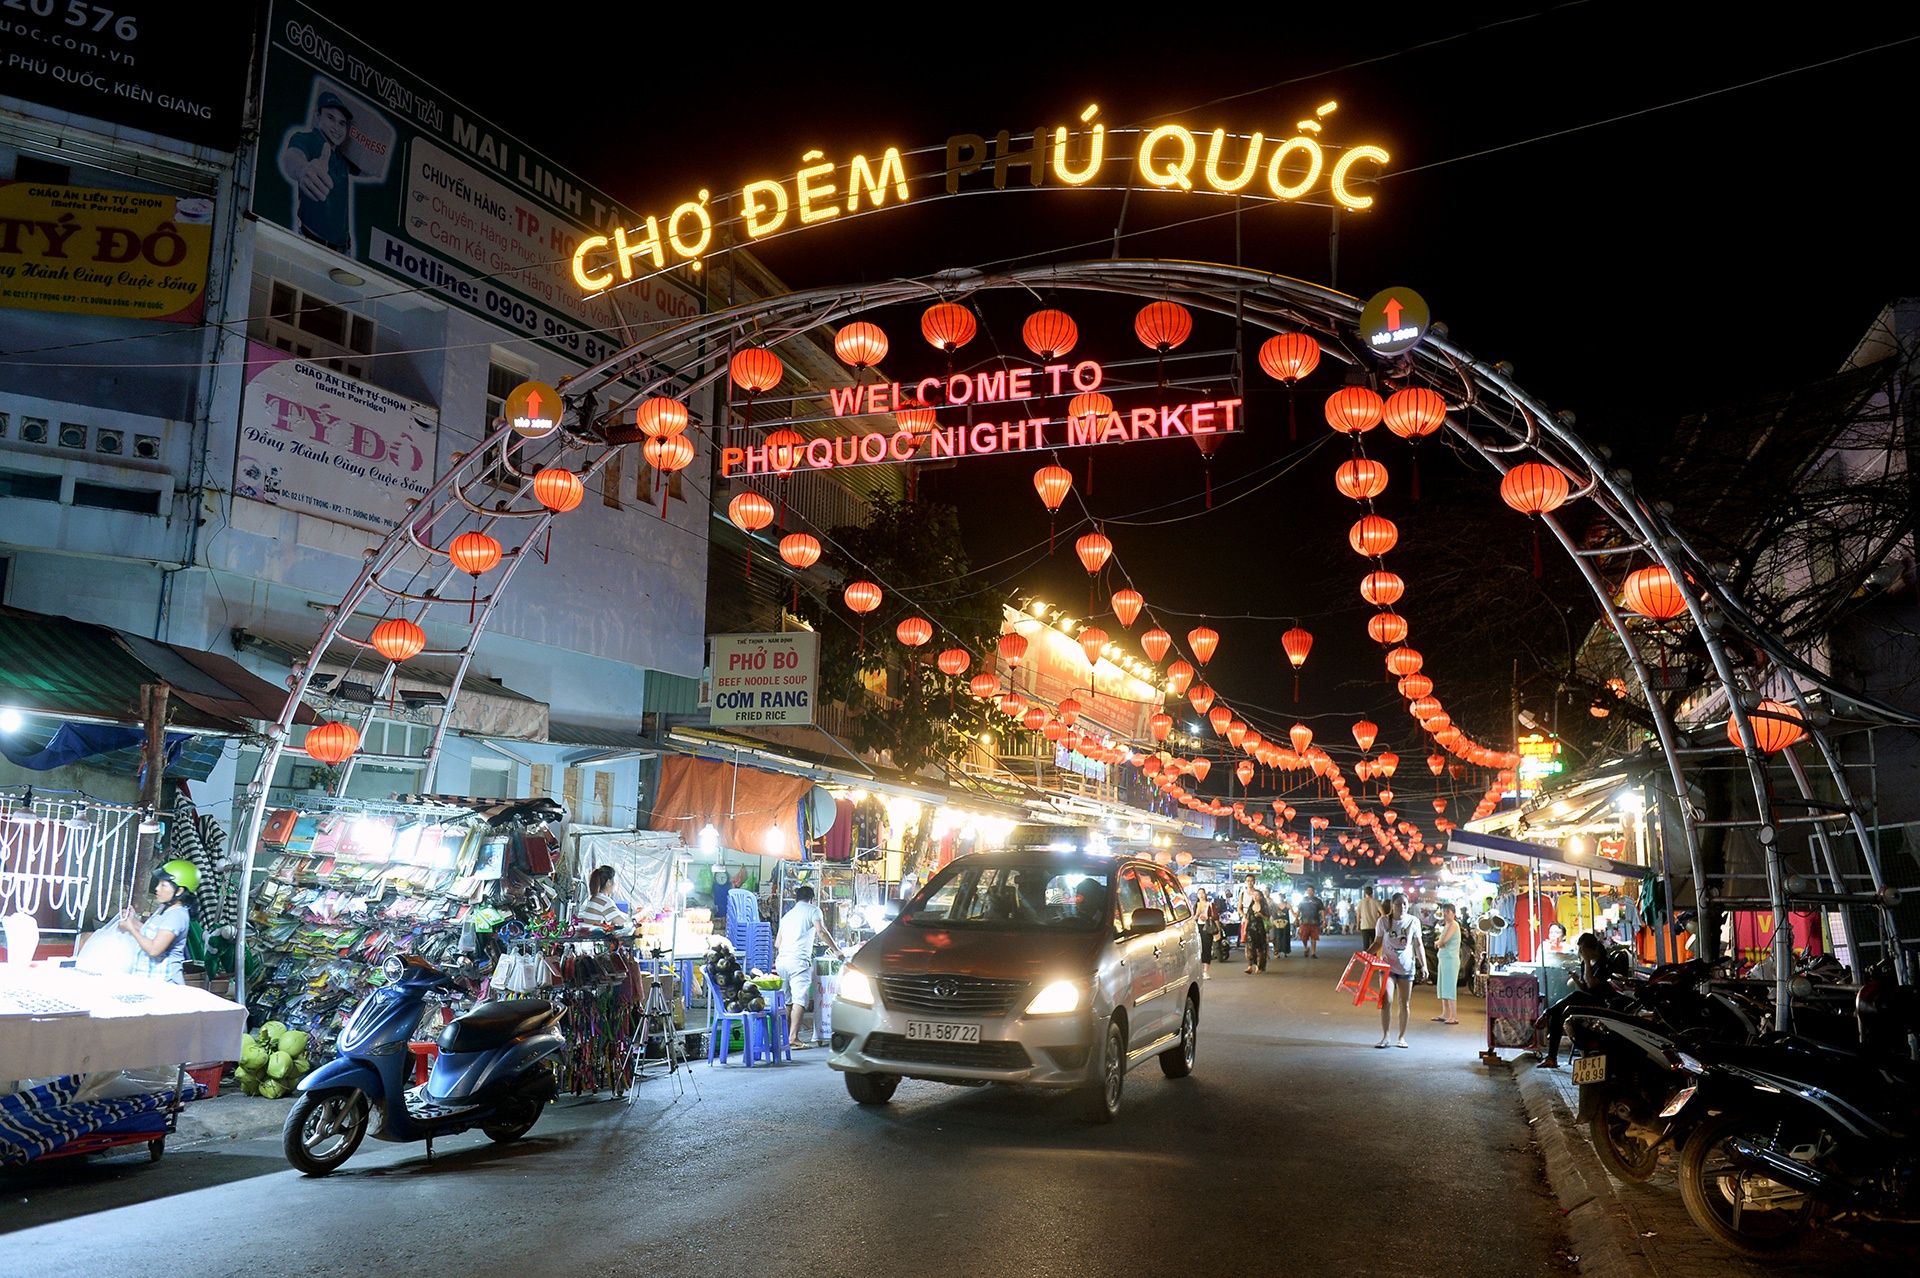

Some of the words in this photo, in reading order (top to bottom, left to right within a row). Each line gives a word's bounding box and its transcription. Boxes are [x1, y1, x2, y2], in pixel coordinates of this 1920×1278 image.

[64, 0, 138, 41] 576
[9, 54, 47, 74] PHÚ
[52, 65, 109, 93] QUỐC,
[115, 81, 152, 103] KIÊN
[158, 94, 212, 119] GIANG
[286, 20, 344, 71] CÔNG
[348, 54, 374, 88] TY
[375, 71, 412, 114] VẬN
[415, 96, 443, 132] TẢI
[453, 114, 508, 171] MAI
[518, 154, 583, 216] LINH
[350, 126, 386, 155] EXPRESS
[51, 200, 86, 210] (Buffet
[91, 203, 138, 214] Porridge)
[474, 193, 506, 221] HÀNG
[515, 205, 544, 244] TP.
[572, 189, 711, 291] CHỢ
[741, 146, 909, 238] ĐÊM
[946, 103, 1104, 195] PHÚ
[1139, 100, 1390, 209] QUỐC
[0, 212, 82, 258] TÝ
[91, 222, 188, 267] ĐÔ
[432, 197, 477, 232] Chuyên:
[481, 222, 508, 252] Hàng
[511, 239, 536, 264] Phục
[22, 262, 69, 281] Hành
[73, 267, 114, 286] Cùng
[117, 271, 154, 290] Cuộc
[158, 275, 198, 294] Sống
[430, 221, 461, 250] Cam
[466, 239, 487, 263] Kết
[490, 253, 519, 278] Giao
[523, 270, 552, 300] Hàng
[556, 285, 586, 317] Trong
[385, 239, 478, 304] Hotline:
[486, 290, 537, 329] 0903
[544, 318, 579, 350] 999
[315, 382, 346, 399] (Buffet
[348, 393, 387, 414] Porridge)
[381, 395, 406, 411] CHỌN
[830, 368, 1033, 416] WELCOME
[1040, 360, 1102, 396] TO
[265, 393, 340, 445] TÝ
[722, 445, 795, 477] PHU
[806, 430, 915, 468] QUOC
[932, 418, 1051, 457] NIGHT
[1067, 400, 1243, 445] MARKET
[244, 426, 286, 452] Đồng
[290, 440, 329, 464] Hành
[334, 452, 366, 477] Cùng
[369, 466, 398, 487] Cuộc
[291, 491, 298, 500] 02
[313, 498, 329, 509] TRỌNG
[332, 504, 342, 513] KP2
[718, 677, 742, 687] BEEF
[744, 676, 780, 686] NOODLE
[783, 675, 807, 685] SOUP
[729, 646, 768, 671] PHỞ
[773, 647, 798, 669] BÒ
[716, 689, 754, 709] CƠM
[760, 690, 808, 708] RANG
[735, 712, 762, 720] FRIED
[765, 711, 786, 720] RICE
[1578, 1057, 1601, 1071] 18-K1
